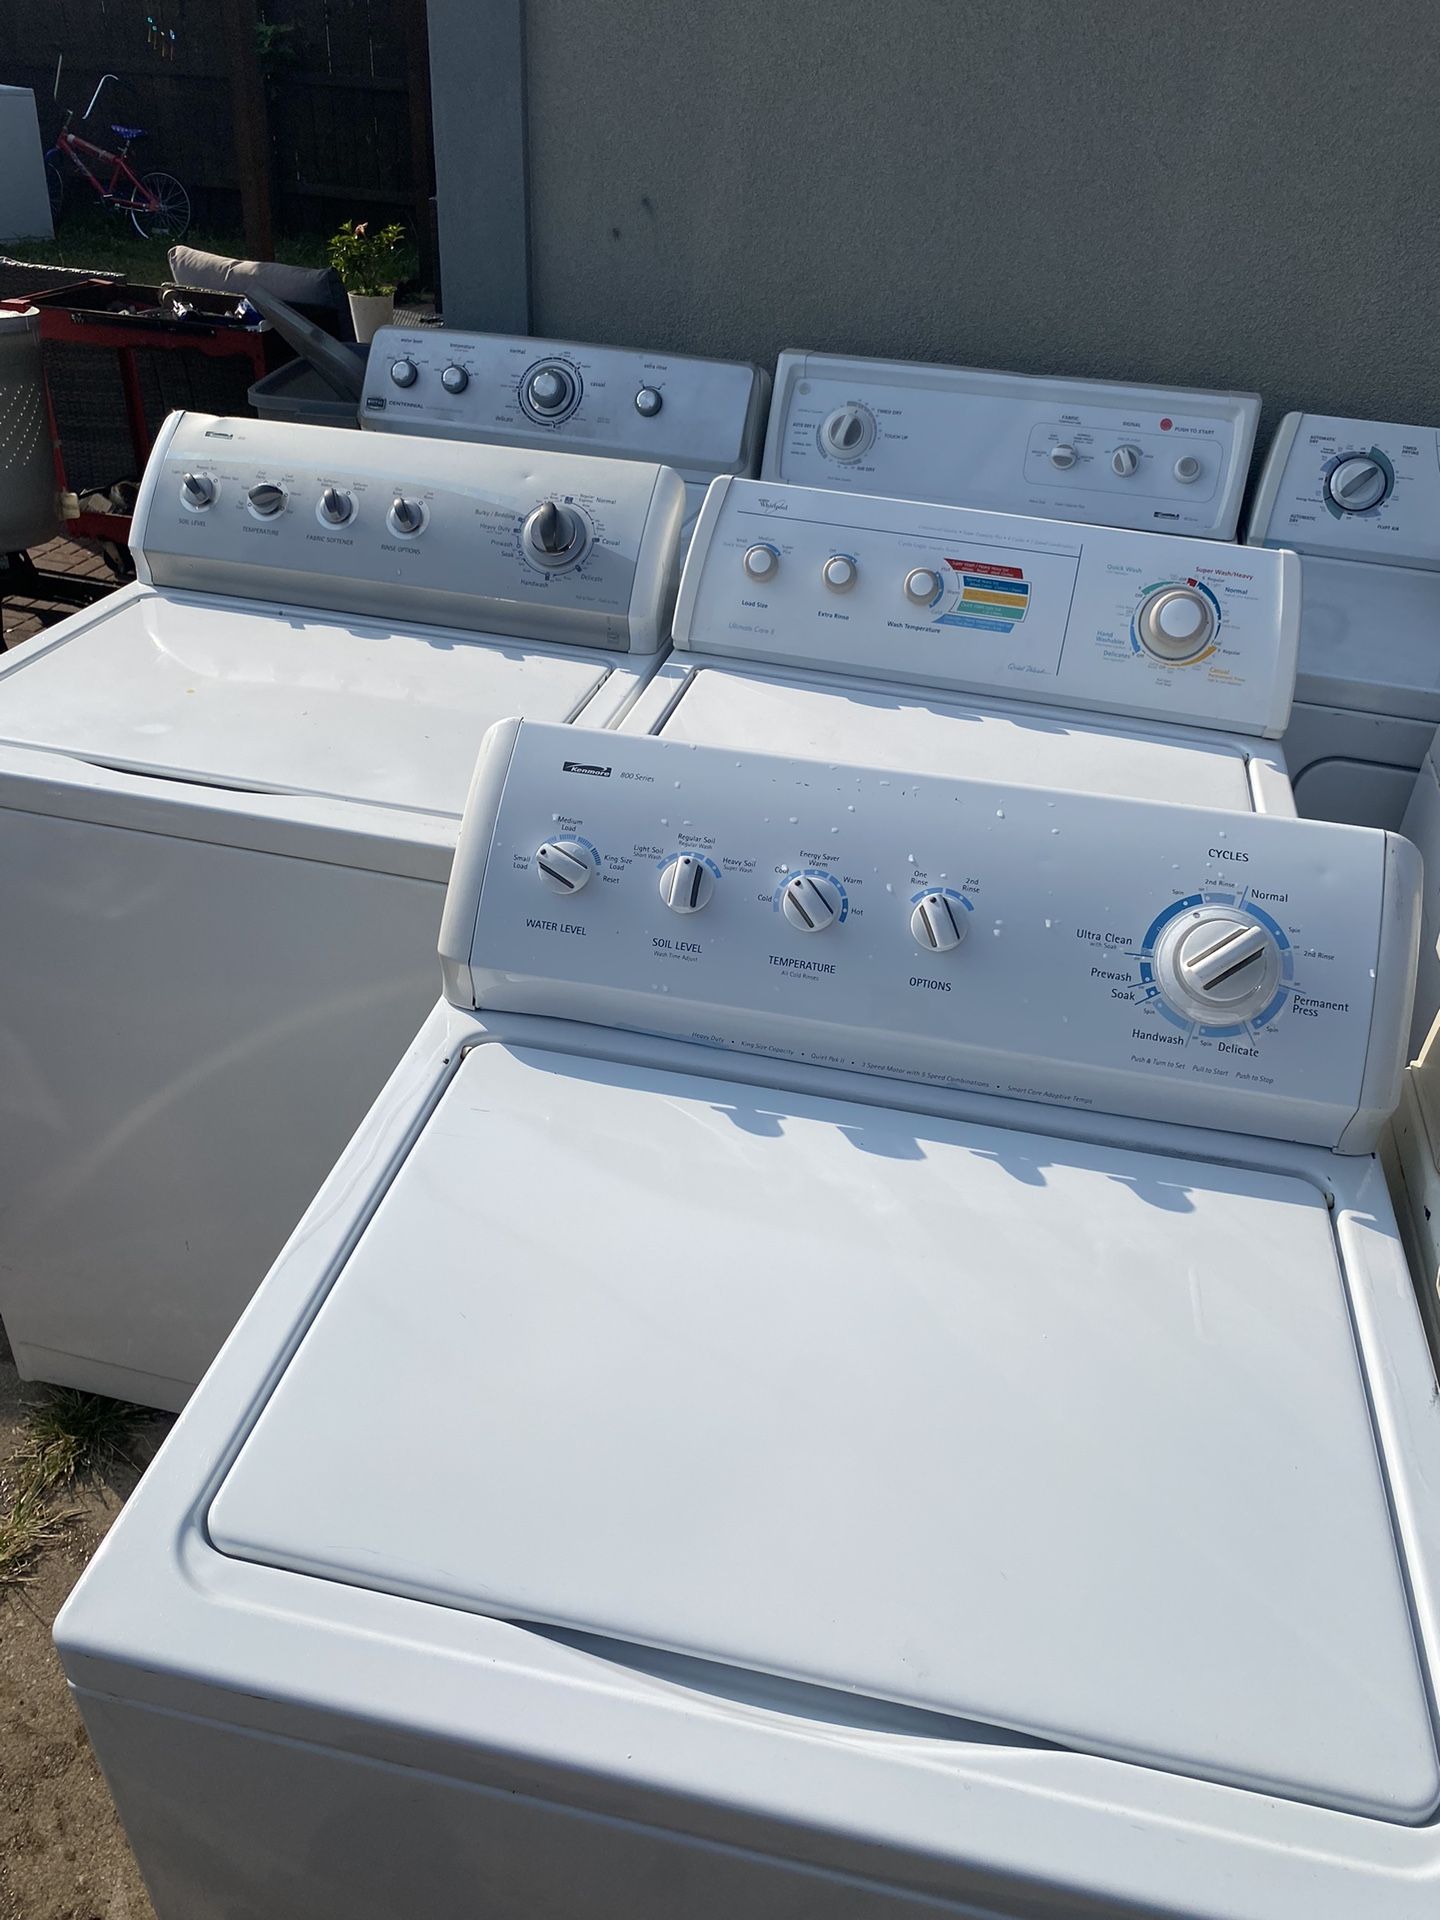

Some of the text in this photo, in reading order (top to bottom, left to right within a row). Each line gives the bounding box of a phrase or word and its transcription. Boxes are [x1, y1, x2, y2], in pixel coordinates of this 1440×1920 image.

[389, 400, 424, 409] CENTENNIAL
[243, 526, 279, 536] TEMPERATURE
[306, 534, 353, 545] FABRIC SOFTENER
[381, 544, 420, 554] RINSE OPTIONS
[580, 574, 603, 582] Delicate
[1196, 566, 1253, 580] Super Wash/Heavy
[521, 579, 548, 587] Handwash
[1225, 587, 1248, 595] Normal
[757, 601, 768, 609] Size
[818, 611, 849, 620] Extra Rinse
[887, 620, 941, 634] Wash Temperature
[1104, 650, 1130, 659] Delicates
[571, 767, 610, 776] Kenmore
[620, 772, 655, 783] 800 Series
[557, 816, 583, 825] Medium
[561, 824, 576, 832] Load
[678, 833, 715, 844] Regular Soil
[633, 845, 650, 853] Light
[679, 840, 698, 848] Regular
[513, 854, 530, 863] Small
[604, 854, 633, 865] King Size
[800, 850, 840, 862] Energy Saver
[1208, 848, 1249, 862] CYCLES
[513, 861, 528, 870] Load
[609, 862, 624, 871] Load
[722, 857, 756, 867] Heavy Soil
[603, 875, 620, 884] Reset
[913, 870, 928, 879] One
[843, 876, 863, 885] Warm
[910, 877, 929, 887] Rinse
[965, 877, 979, 886] 2nd
[1204, 878, 1235, 889] 2nd Rinse
[962, 884, 980, 894] Rinse
[757, 894, 772, 902] Cold
[1251, 889, 1289, 903] Normal
[851, 908, 863, 916] Hot
[526, 918, 587, 936] WATER LEVEL
[1076, 929, 1133, 945] Ultra Clean
[652, 938, 703, 953] SOIL LEVEL
[1304, 950, 1335, 960] 2nd Rinse
[768, 955, 836, 974] TEMPERATURE
[803, 973, 819, 981] Rinses
[1090, 967, 1132, 982] Prewash
[909, 977, 952, 992] OPTIONS
[1111, 988, 1136, 1001] Soak
[1294, 994, 1349, 1012] Permanent
[1292, 1004, 1318, 1017] Press
[1132, 1028, 1184, 1045] Handwash
[1218, 1041, 1259, 1058] Delicate
[692, 1032, 710, 1041] Heavy
[711, 1035, 725, 1043] Duty
[741, 1041, 755, 1049] King
[768, 1045, 794, 1056] Capacity
[811, 1053, 828, 1061] Quiet
[867, 1062, 886, 1071] Speed
[886, 1065, 905, 1074] Motor
[927, 1072, 945, 1081] Speed
[946, 1076, 990, 1088] Combinations
[1007, 1085, 1026, 1095] Smart
[1044, 1091, 1071, 1101] Adaptive
[1073, 1095, 1093, 1104] Temps
[1131, 1055, 1146, 1064] Push
[1153, 1058, 1166, 1067] Turn
[1174, 1062, 1186, 1070] Set
[1192, 1064, 1204, 1073] Pull
[1213, 1067, 1228, 1076] Start
[1236, 1072, 1250, 1080] Push
[1259, 1076, 1274, 1084] Stop
